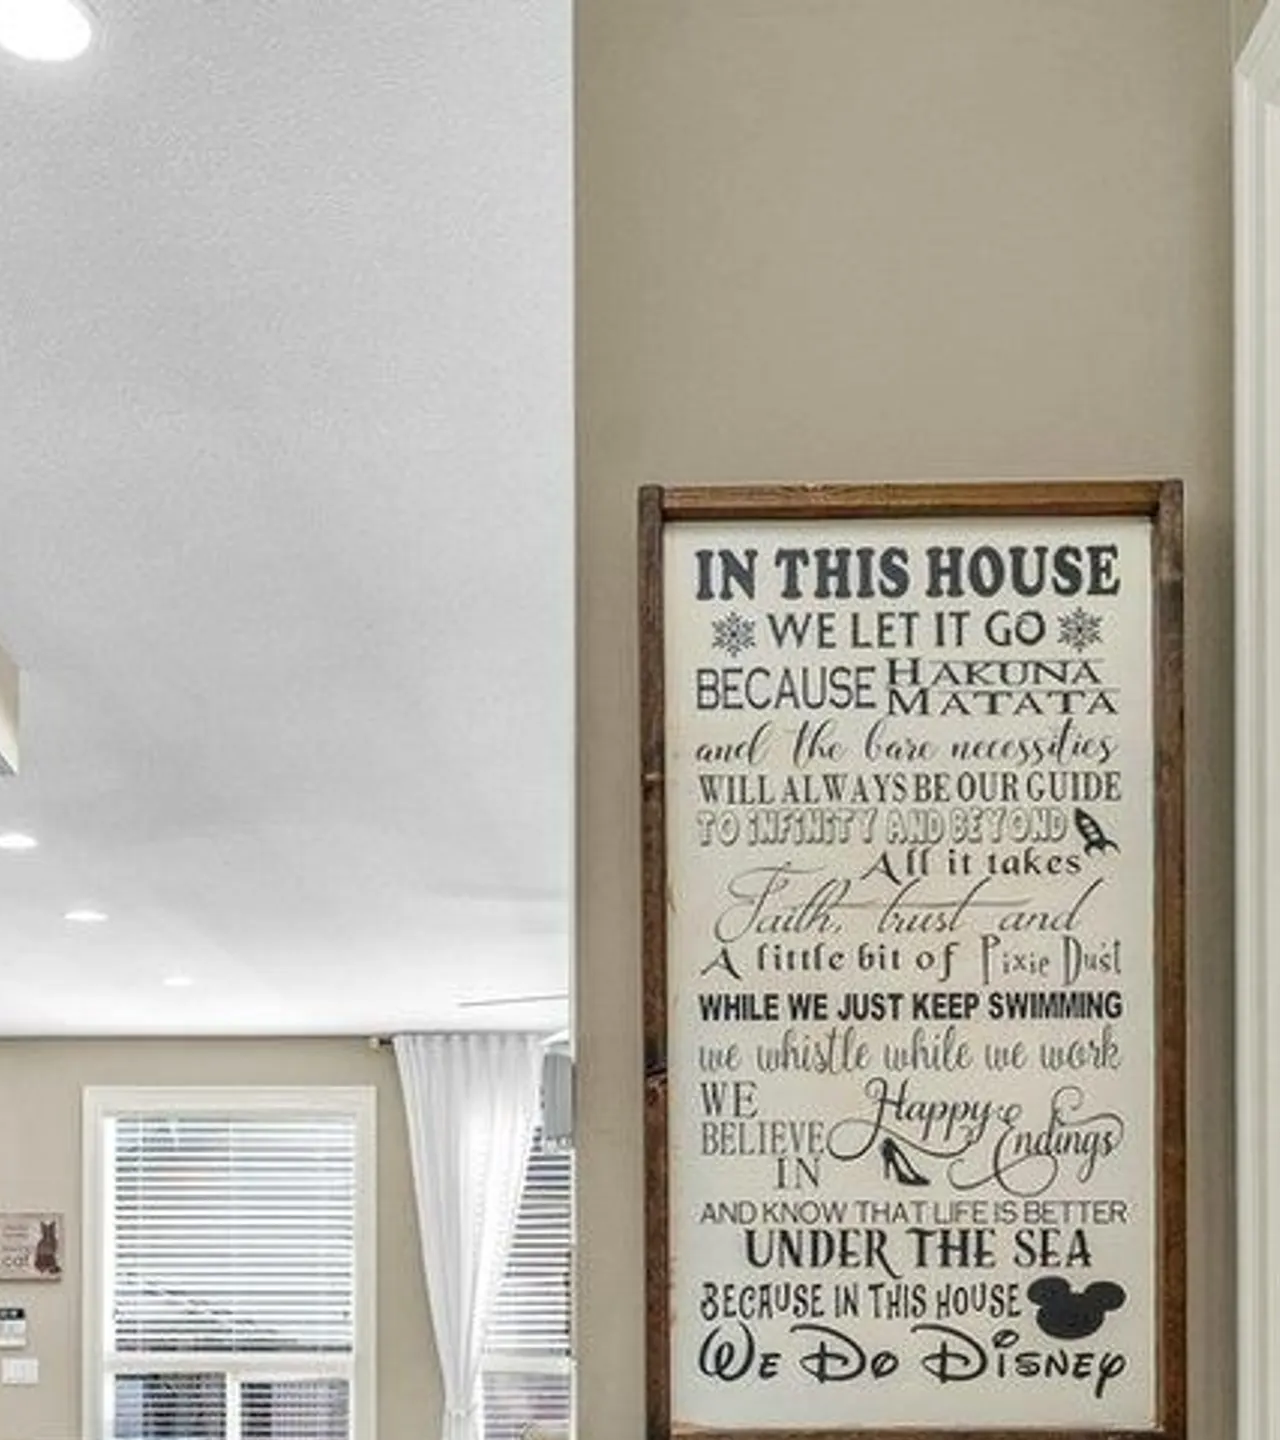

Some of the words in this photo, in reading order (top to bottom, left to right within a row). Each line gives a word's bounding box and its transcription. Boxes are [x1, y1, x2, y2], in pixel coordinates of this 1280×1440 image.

[695, 548, 759, 600] IN
[775, 546, 911, 600] THIS
[925, 544, 1121, 599] HOUSE
[766, 611, 837, 649] WE
[851, 611, 920, 649] LET
[935, 611, 971, 648] IT
[985, 609, 1047, 647] GO
[696, 666, 877, 710] BECAUSE
[887, 657, 1103, 687] HAKUNA
[887, 688, 1121, 716] MATATA
[695, 720, 772, 766] and
[790, 719, 846, 769] the
[864, 715, 934, 763] bare
[951, 717, 1119, 769] necessities
[698, 773, 780, 804] WILL
[783, 772, 907, 803] ALWAYS
[914, 772, 952, 802] BE
[957, 771, 1019, 802] OUR
[1026, 771, 1123, 801] GUIDE
[697, 810, 740, 847] TO
[886, 807, 944, 845] AND
[952, 806, 1068, 843] BEYOND
[862, 848, 930, 885] All
[948, 850, 971, 875] it
[987, 847, 1083, 876] takes
[714, 861, 853, 943] Faith,
[878, 876, 993, 934] trust
[998, 877, 1105, 932] and
[700, 946, 741, 980] A
[757, 942, 845, 972] little
[857, 941, 901, 972] bit
[915, 941, 961, 982] of
[980, 934, 1050, 985] Pixie
[1062, 935, 1122, 987] Dust
[698, 993, 780, 1021] WHILE
[787, 993, 829, 1021] WE
[837, 992, 905, 1021] JUST
[912, 992, 979, 1020] KEEP
[987, 990, 1124, 1020] SWIMMING
[698, 1040, 741, 1073] we
[756, 1025, 872, 1075] whistle
[883, 1025, 974, 1073] while
[985, 1038, 1028, 1072] we
[1040, 1023, 1123, 1072] work
[699, 1081, 759, 1119] WE
[826, 1076, 1024, 1162] Happy
[700, 1121, 825, 1157] BELIEVE
[947, 1085, 1126, 1198] Endings
[774, 1156, 821, 1190] IN
[699, 1201, 759, 1225] AND
[762, 1201, 846, 1225] KNOW
[853, 1201, 930, 1224] THAT
[934, 1200, 988, 1224] LIFE
[993, 1200, 1017, 1224] IS
[1023, 1200, 1128, 1224] BETTER
[744, 1229, 903, 1279] UNDER
[906, 1227, 997, 1269] THE
[1013, 1227, 1093, 1269] SEA
[700, 1281, 825, 1321] BECAUSE
[834, 1283, 861, 1320] IN
[868, 1282, 927, 1320] THIS
[936, 1281, 1023, 1319] HOUSE
